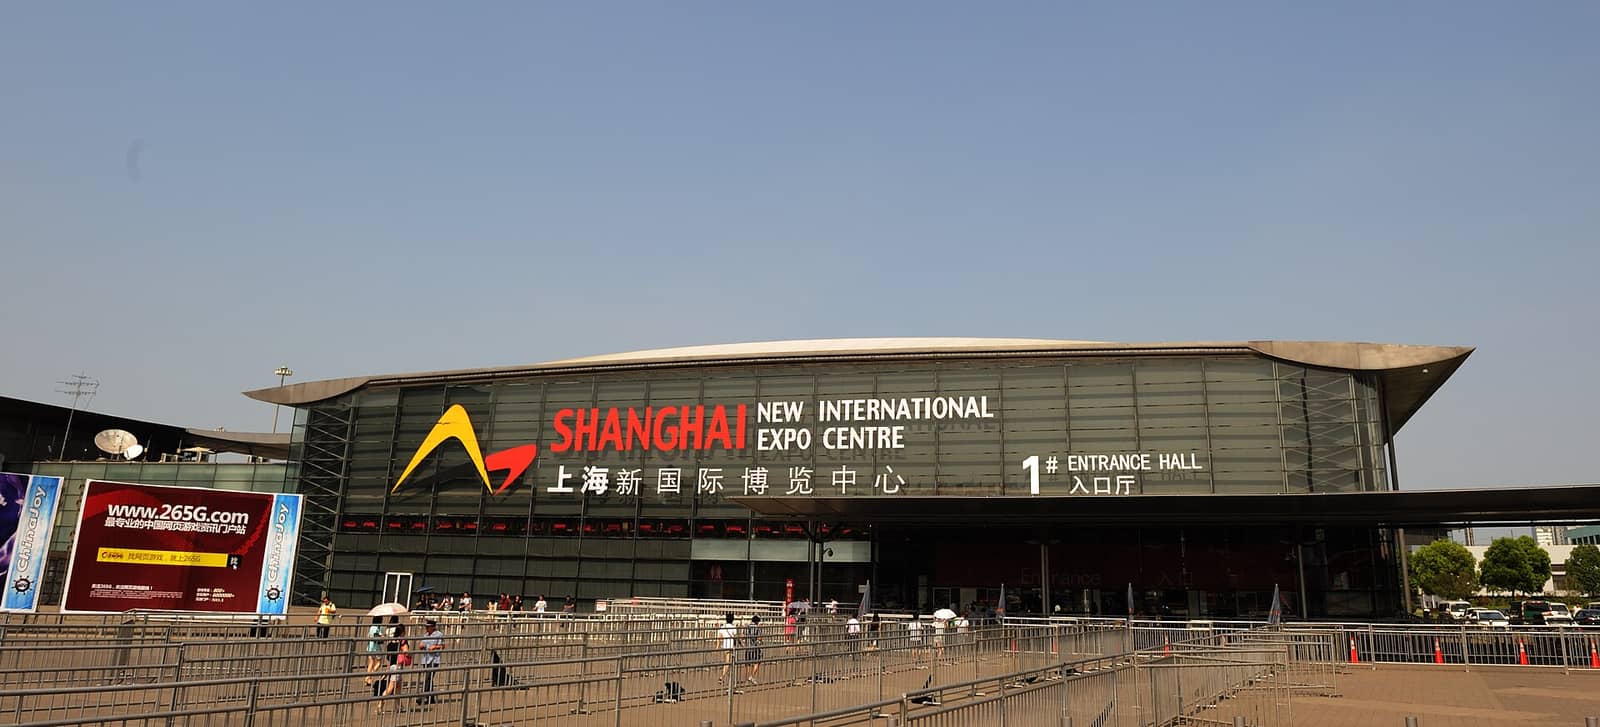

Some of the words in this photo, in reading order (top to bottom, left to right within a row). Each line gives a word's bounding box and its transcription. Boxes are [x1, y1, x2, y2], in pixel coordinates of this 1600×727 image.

[757, 401, 804, 422] NEW
[819, 396, 994, 422] INTERNATIONAL
[550, 404, 747, 452] SHANGHAI
[757, 428, 811, 451] EXPO
[823, 426, 905, 450] CENTRE
[1067, 454, 1152, 472] ENTRANCE
[1159, 453, 1203, 470] HALL
[1069, 475, 1136, 495] 入口厅
[107, 503, 249, 525] www.265G.com
[17, 485, 47, 573] ChinaJoy
[268, 503, 289, 582] ChinaJoy
